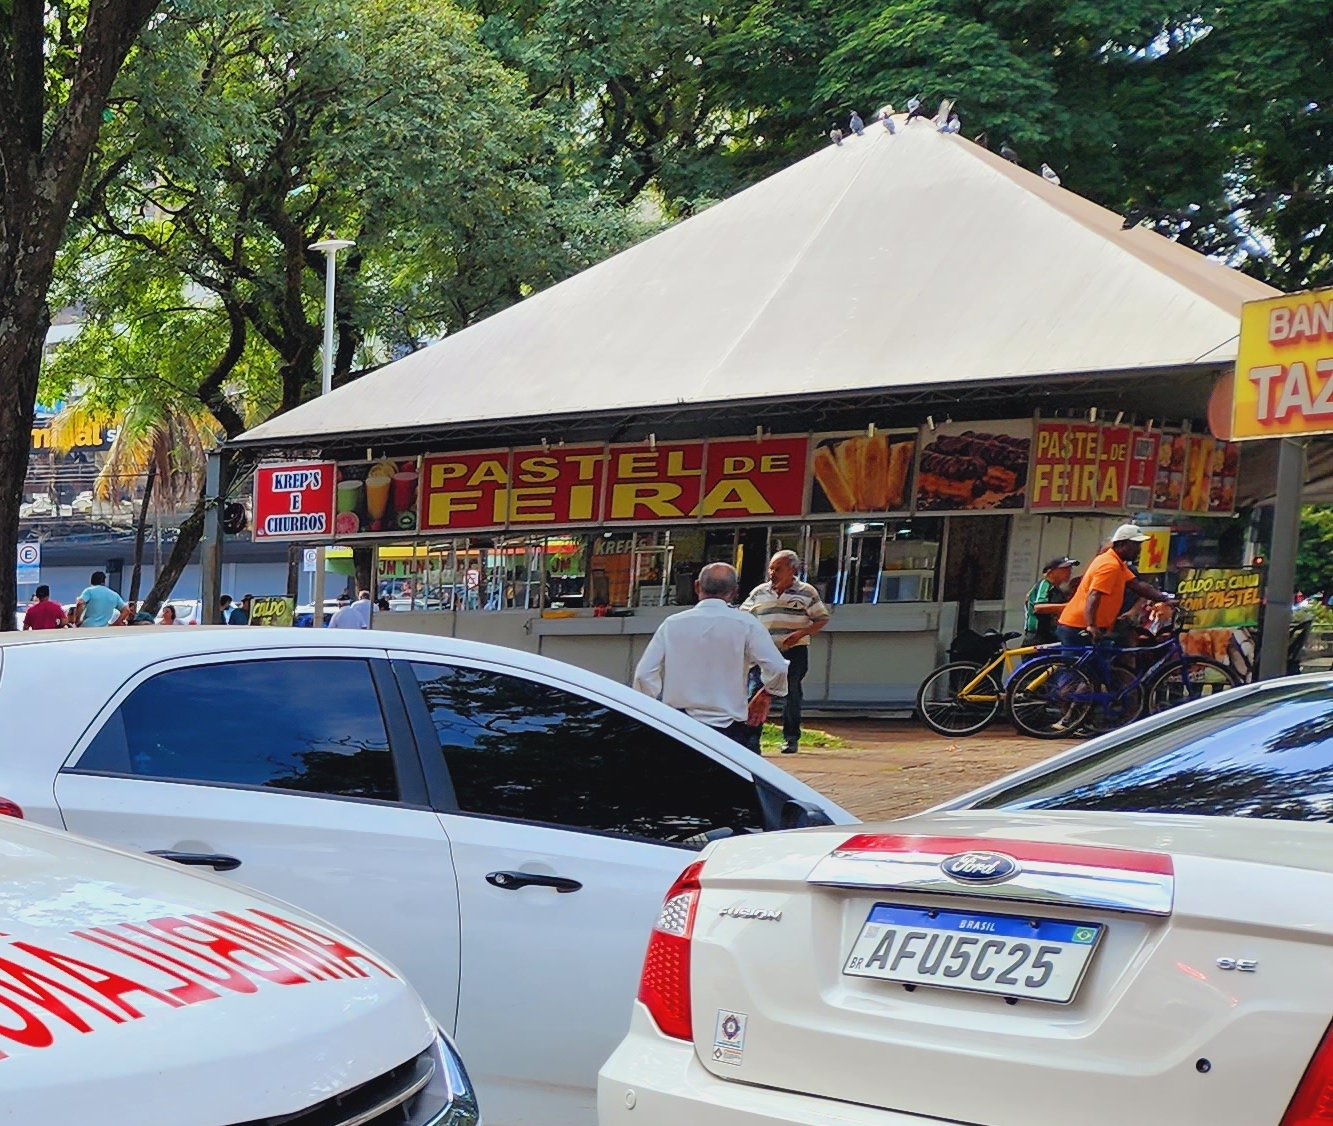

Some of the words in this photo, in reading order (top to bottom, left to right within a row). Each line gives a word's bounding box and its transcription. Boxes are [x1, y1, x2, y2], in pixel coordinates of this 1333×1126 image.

[1268, 301, 1333, 343] BAN
[1037, 431, 1108, 461] PASTEL
[1110, 443, 1127, 462] DE
[430, 450, 706, 488] PASTEL
[723, 455, 790, 475] DE
[274, 471, 321, 490] KREP'S
[1033, 464, 1119, 503] FEIRA
[292, 495, 300, 510] E
[428, 479, 776, 527] FEIRA
[267, 514, 325, 533] CHURROS
[1177, 578, 1214, 593] CALDO
[1205, 587, 1261, 609] PASTEL
[950, 853, 999, 875] Ford
[718, 906, 782, 922] FUSION
[958, 919, 996, 932] BRASIL
[849, 956, 863, 970] BR
[865, 929, 1062, 988] AFU5C25
